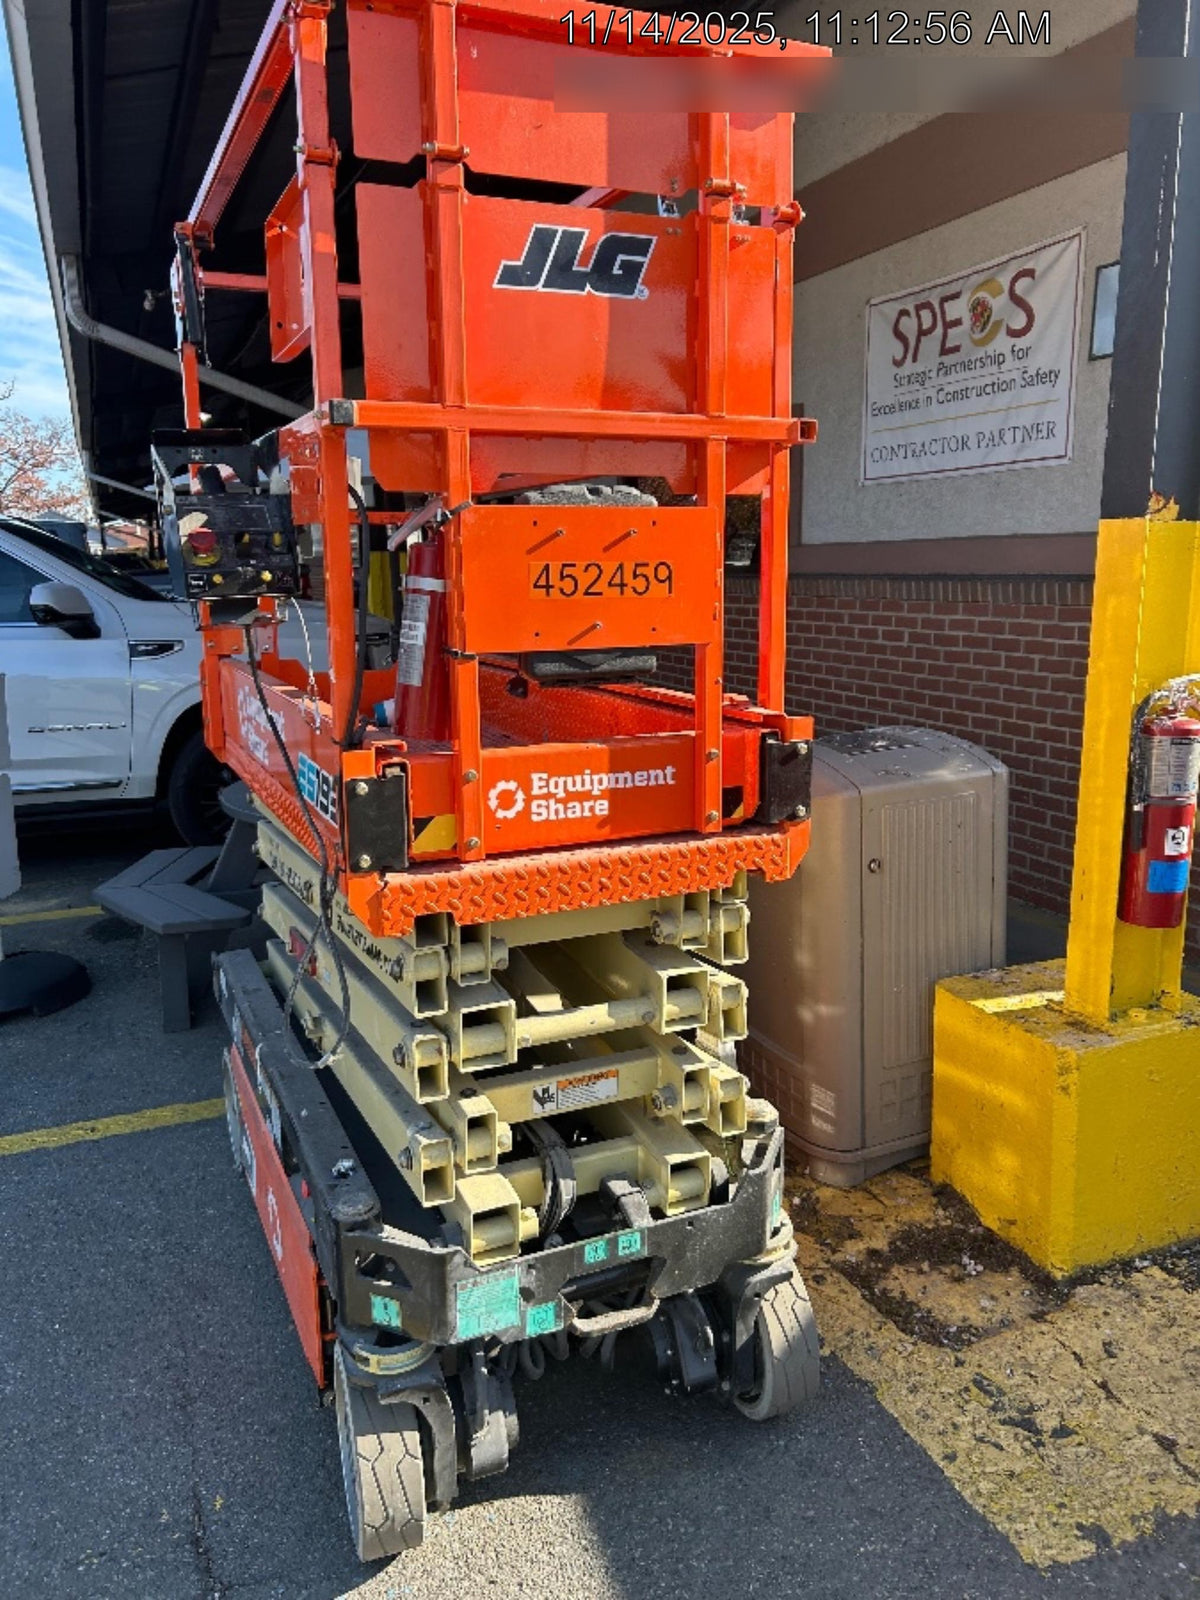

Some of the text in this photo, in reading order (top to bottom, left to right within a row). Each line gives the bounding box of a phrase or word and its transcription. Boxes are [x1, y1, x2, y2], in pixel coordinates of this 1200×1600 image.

[492, 223, 657, 299] JLG
[892, 268, 1036, 368] SPECS
[893, 344, 1032, 388] Strategic Partnership for
[871, 367, 1061, 417] Excellence in Construction Safety
[870, 420, 1057, 463] CONTRACTOR PARTNER
[532, 561, 673, 597] 452459
[531, 765, 676, 798] Equipment
[531, 798, 609, 822] Share
